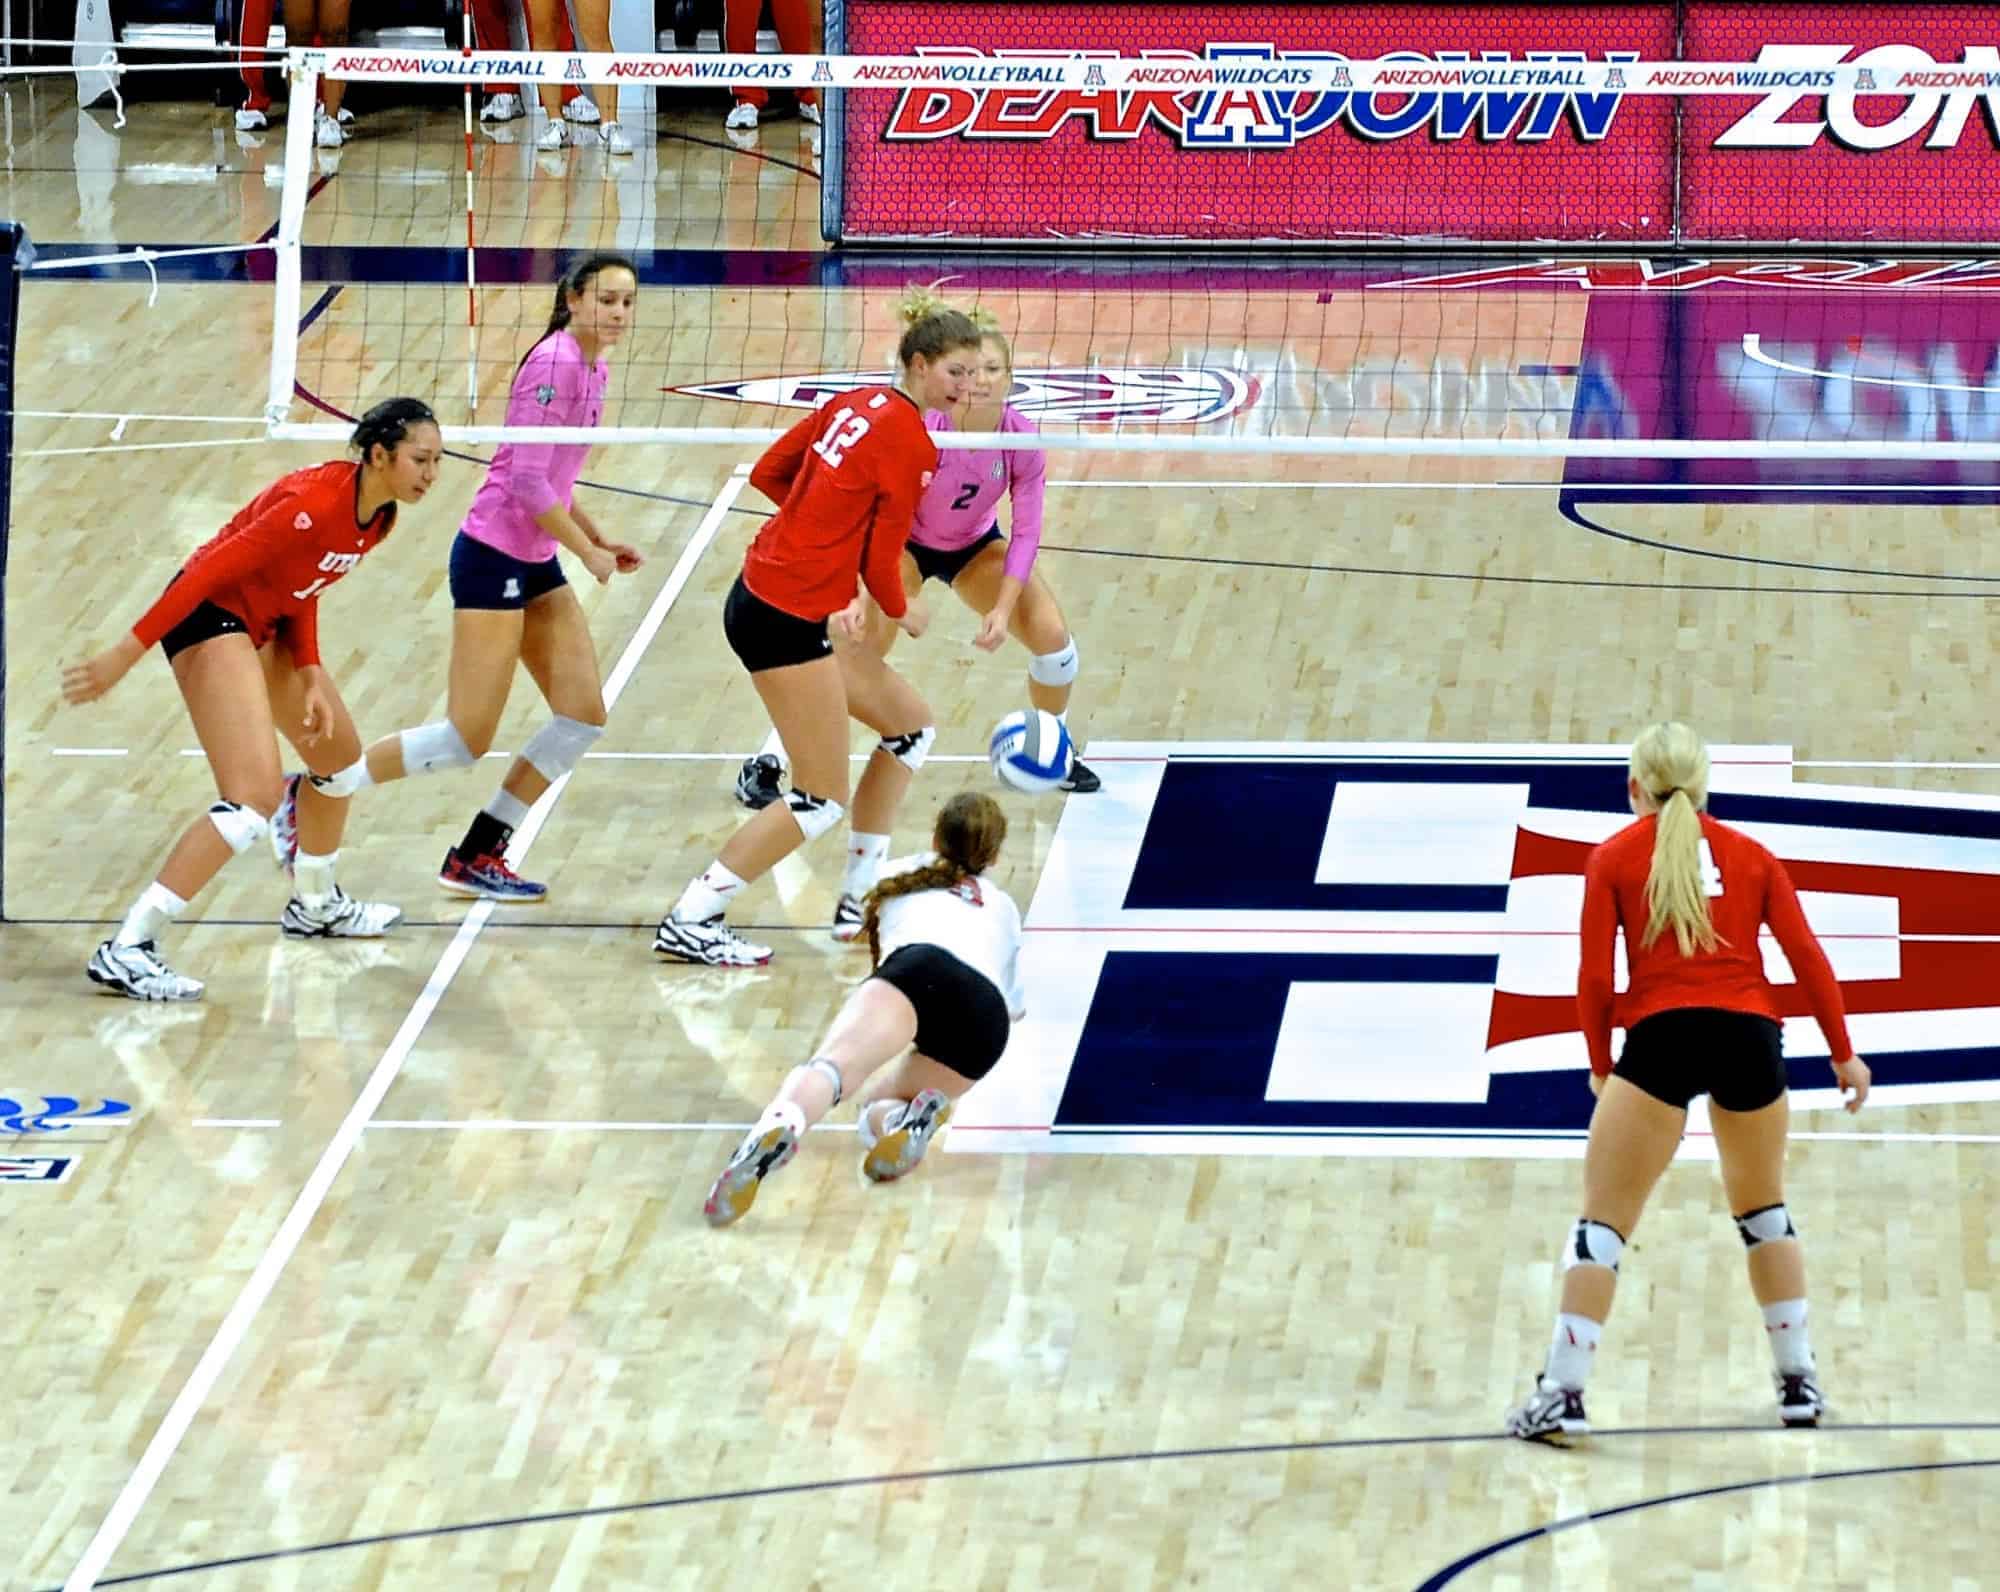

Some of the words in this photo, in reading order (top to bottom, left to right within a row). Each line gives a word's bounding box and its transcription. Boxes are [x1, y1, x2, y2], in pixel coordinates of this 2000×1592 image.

[332, 57, 546, 77] ARIZONAVOLLEYBALL
[606, 62, 793, 79] ARIZONAWILDCATS
[853, 64, 1065, 82] ARIZONAVOLLEYBALL
[1125, 67, 1313, 84] ARIZONAWILDCATS
[1373, 69, 1586, 86] ARIZONAVOLLEYBALL
[1646, 71, 1836, 87] ARIZONAWILDCATS
[1895, 71, 2000, 88] ARIZONAV
[950, 483, 980, 511] 2
